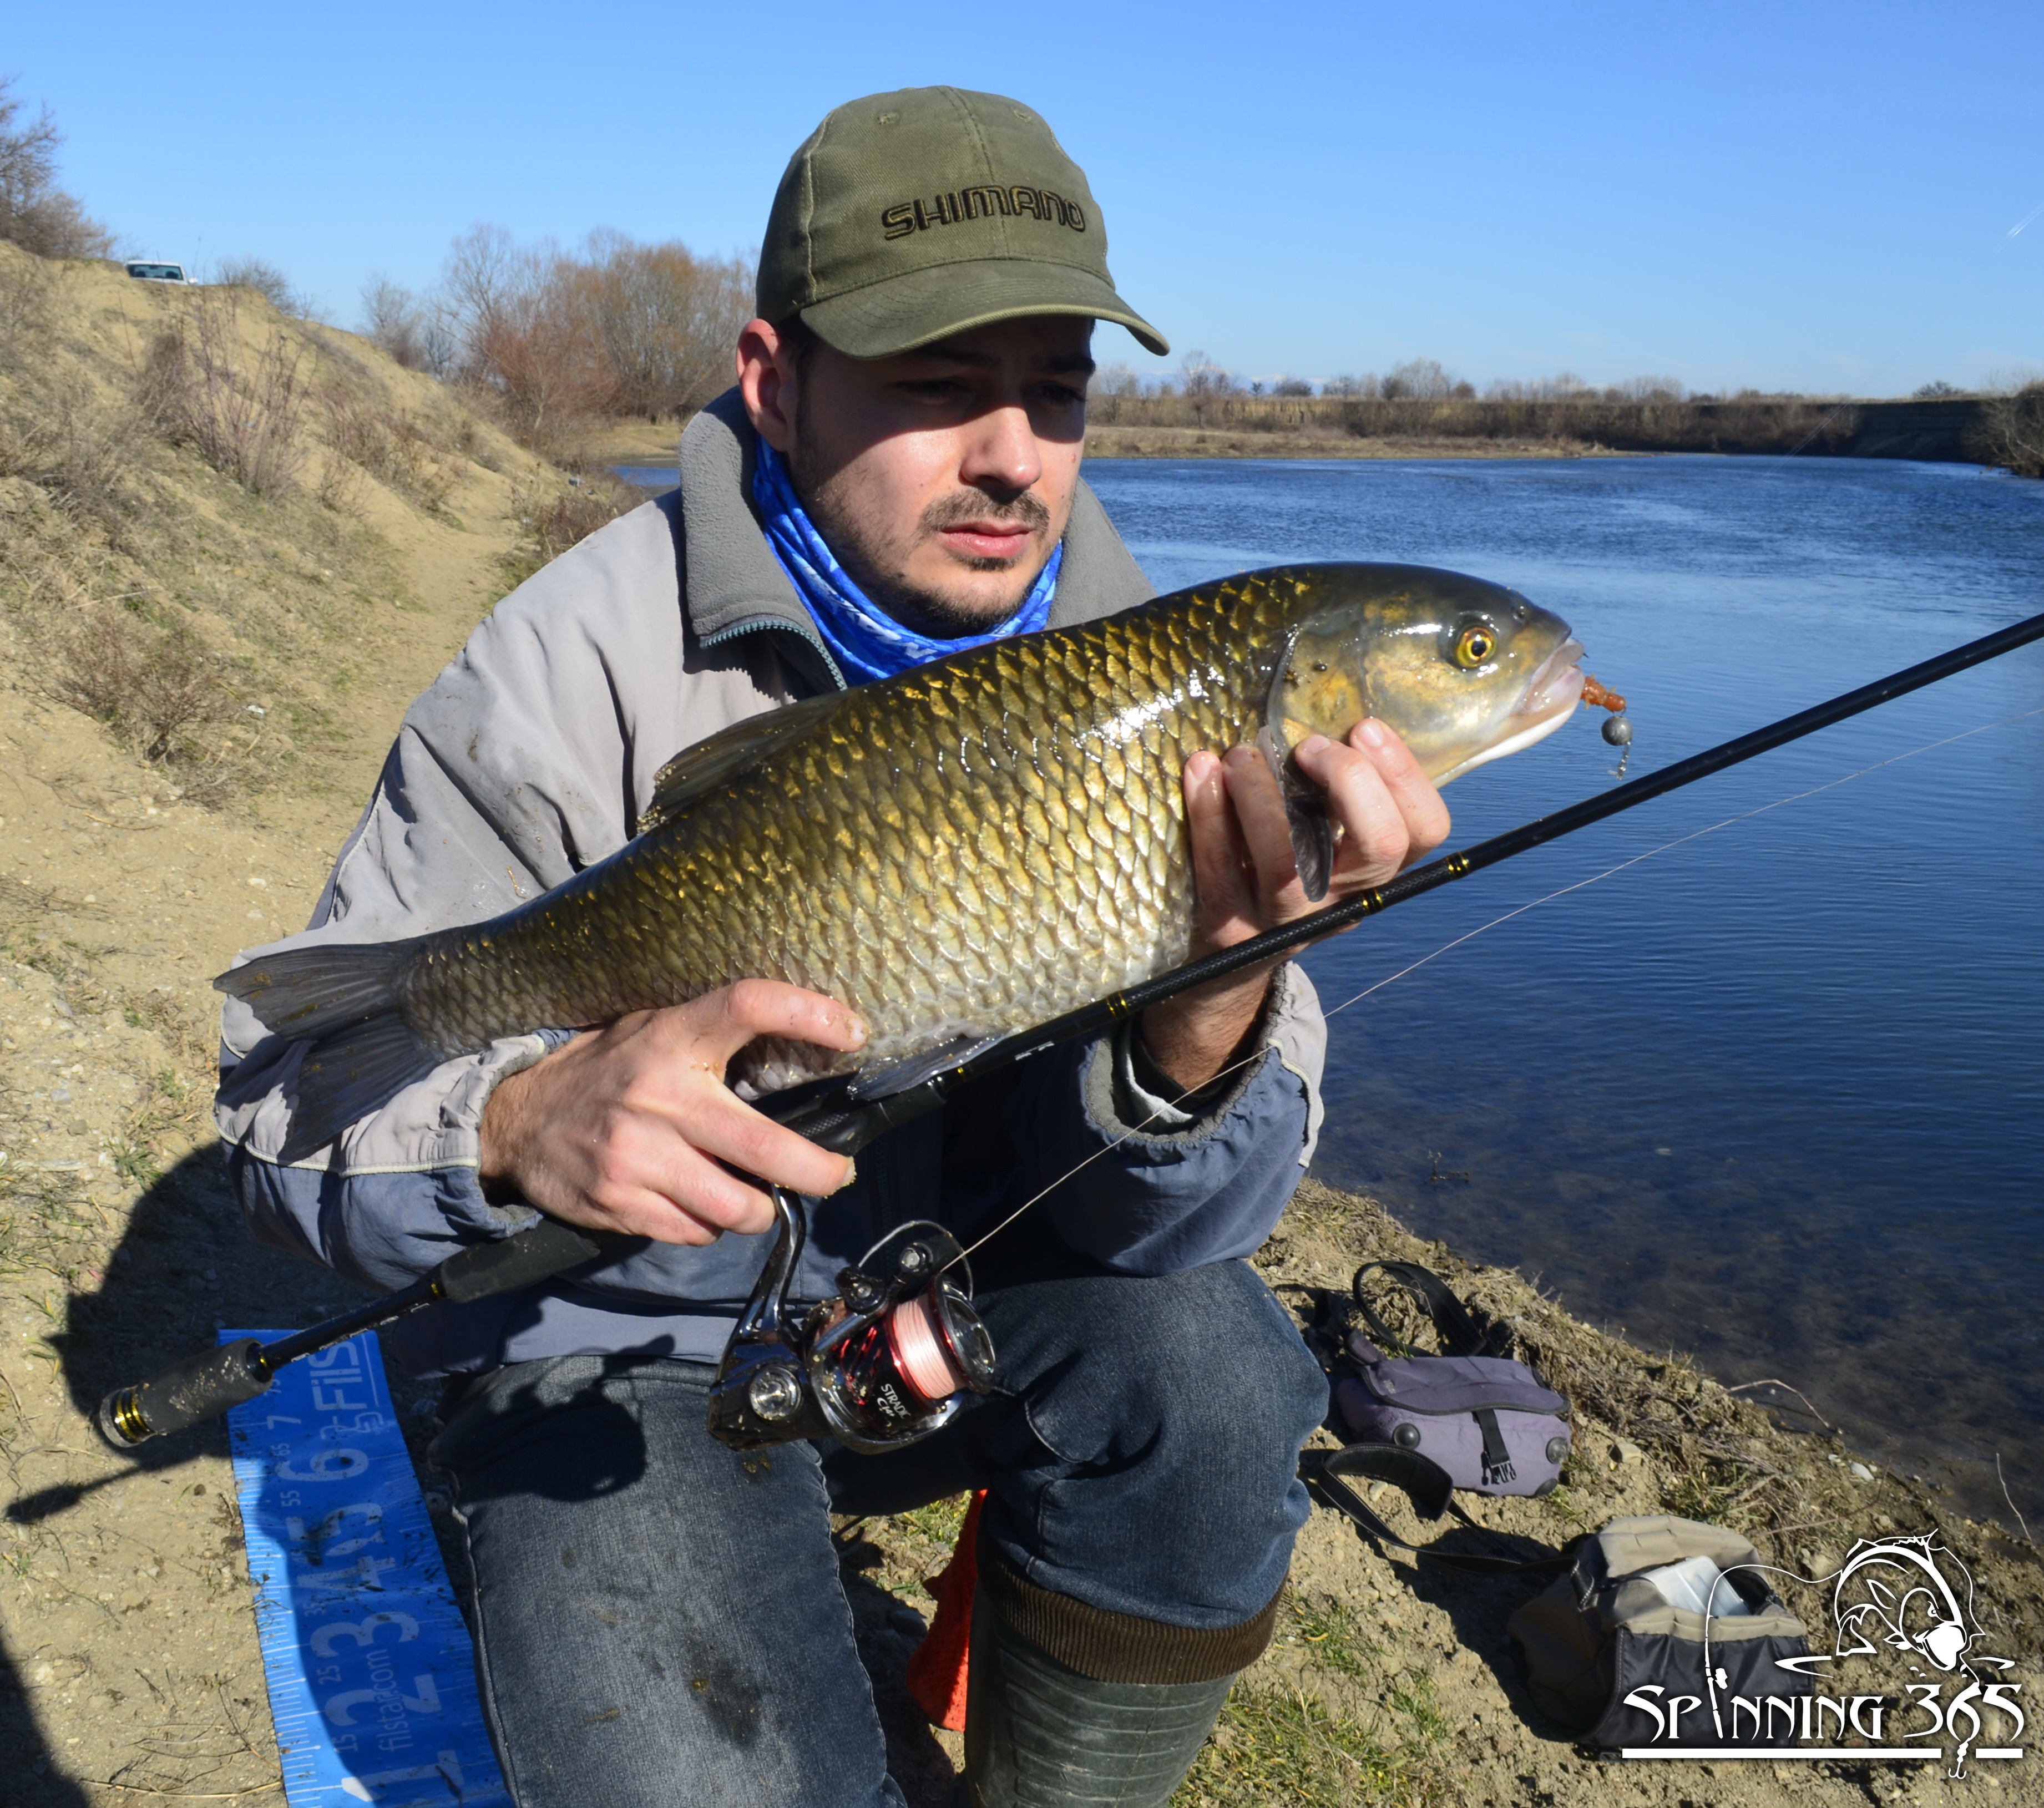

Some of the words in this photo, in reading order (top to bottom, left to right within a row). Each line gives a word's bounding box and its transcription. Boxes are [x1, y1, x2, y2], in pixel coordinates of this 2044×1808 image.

[881, 185, 1086, 241] SHIMANO
[881, 1384, 911, 1419] STRADIC
[267, 1415, 301, 1430] 7
[273, 1443, 291, 1457] 65
[276, 1449, 369, 1482] 6
[281, 1490, 301, 1507] 55
[297, 1556, 396, 1592] 4
[310, 1612, 420, 1658] 3
[316, 1665, 342, 1685] 25
[325, 1673, 442, 1726] 2
[366, 1649, 414, 1752] filstar.com
[334, 1734, 359, 1752] 15
[341, 1749, 465, 1802] 1
